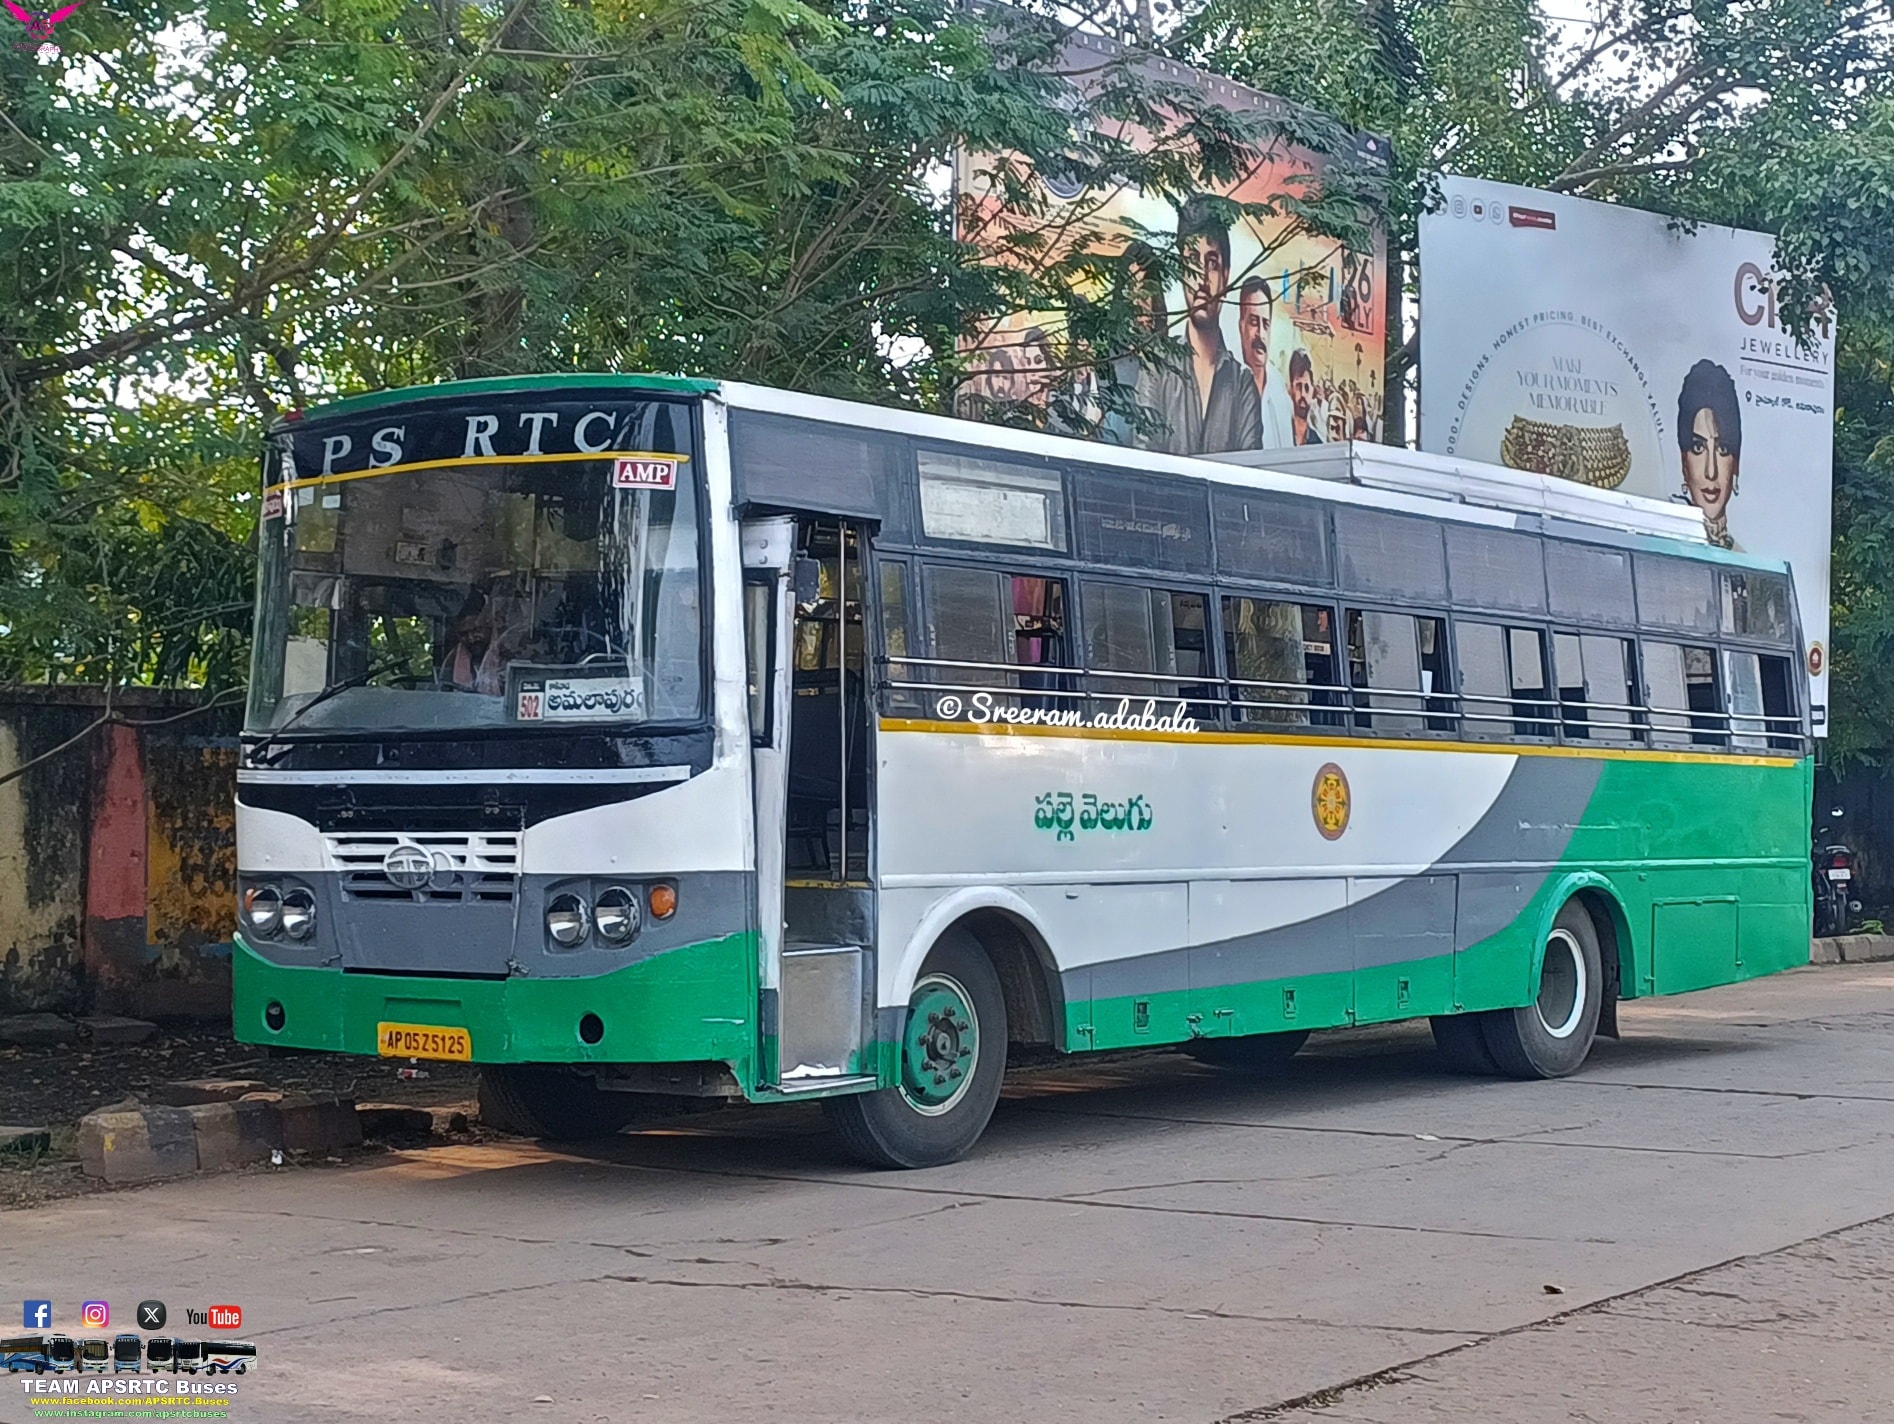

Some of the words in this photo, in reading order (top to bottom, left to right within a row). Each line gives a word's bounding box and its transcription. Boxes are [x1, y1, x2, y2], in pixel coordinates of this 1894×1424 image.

[1457, 354, 1493, 410] DESIGNS.
[1493, 317, 1530, 350] HONEST
[1533, 310, 1577, 324] PRICING.
[1606, 331, 1649, 388] EXCHANGE
[1740, 337, 1830, 366] JEWELLERY
[1556, 375, 1619, 397] MOMENTS
[619, 462, 671, 485] AMP
[519, 695, 540, 719] 502
[1034, 791, 1075, 842] పల్లె
[1079, 793, 1153, 831] వెలుగు
